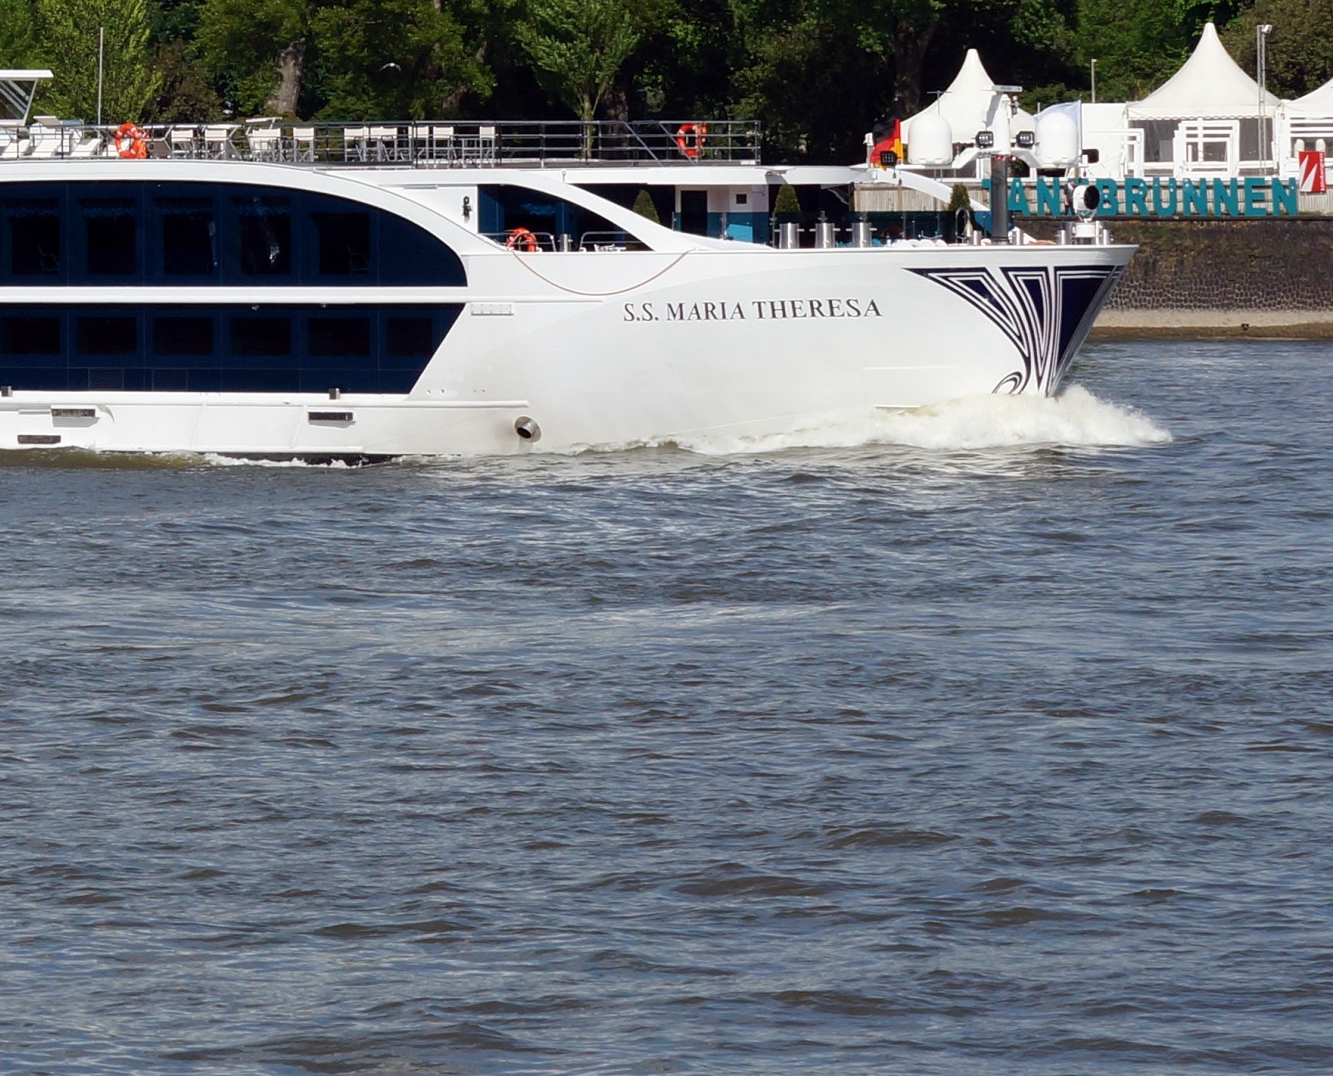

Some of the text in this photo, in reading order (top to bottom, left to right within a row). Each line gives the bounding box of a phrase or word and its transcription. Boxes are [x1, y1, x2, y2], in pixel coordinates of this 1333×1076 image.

[982, 177, 1298, 217] ANBRUNNEN
[624, 299, 883, 322] S.S. MARIA THERESA
